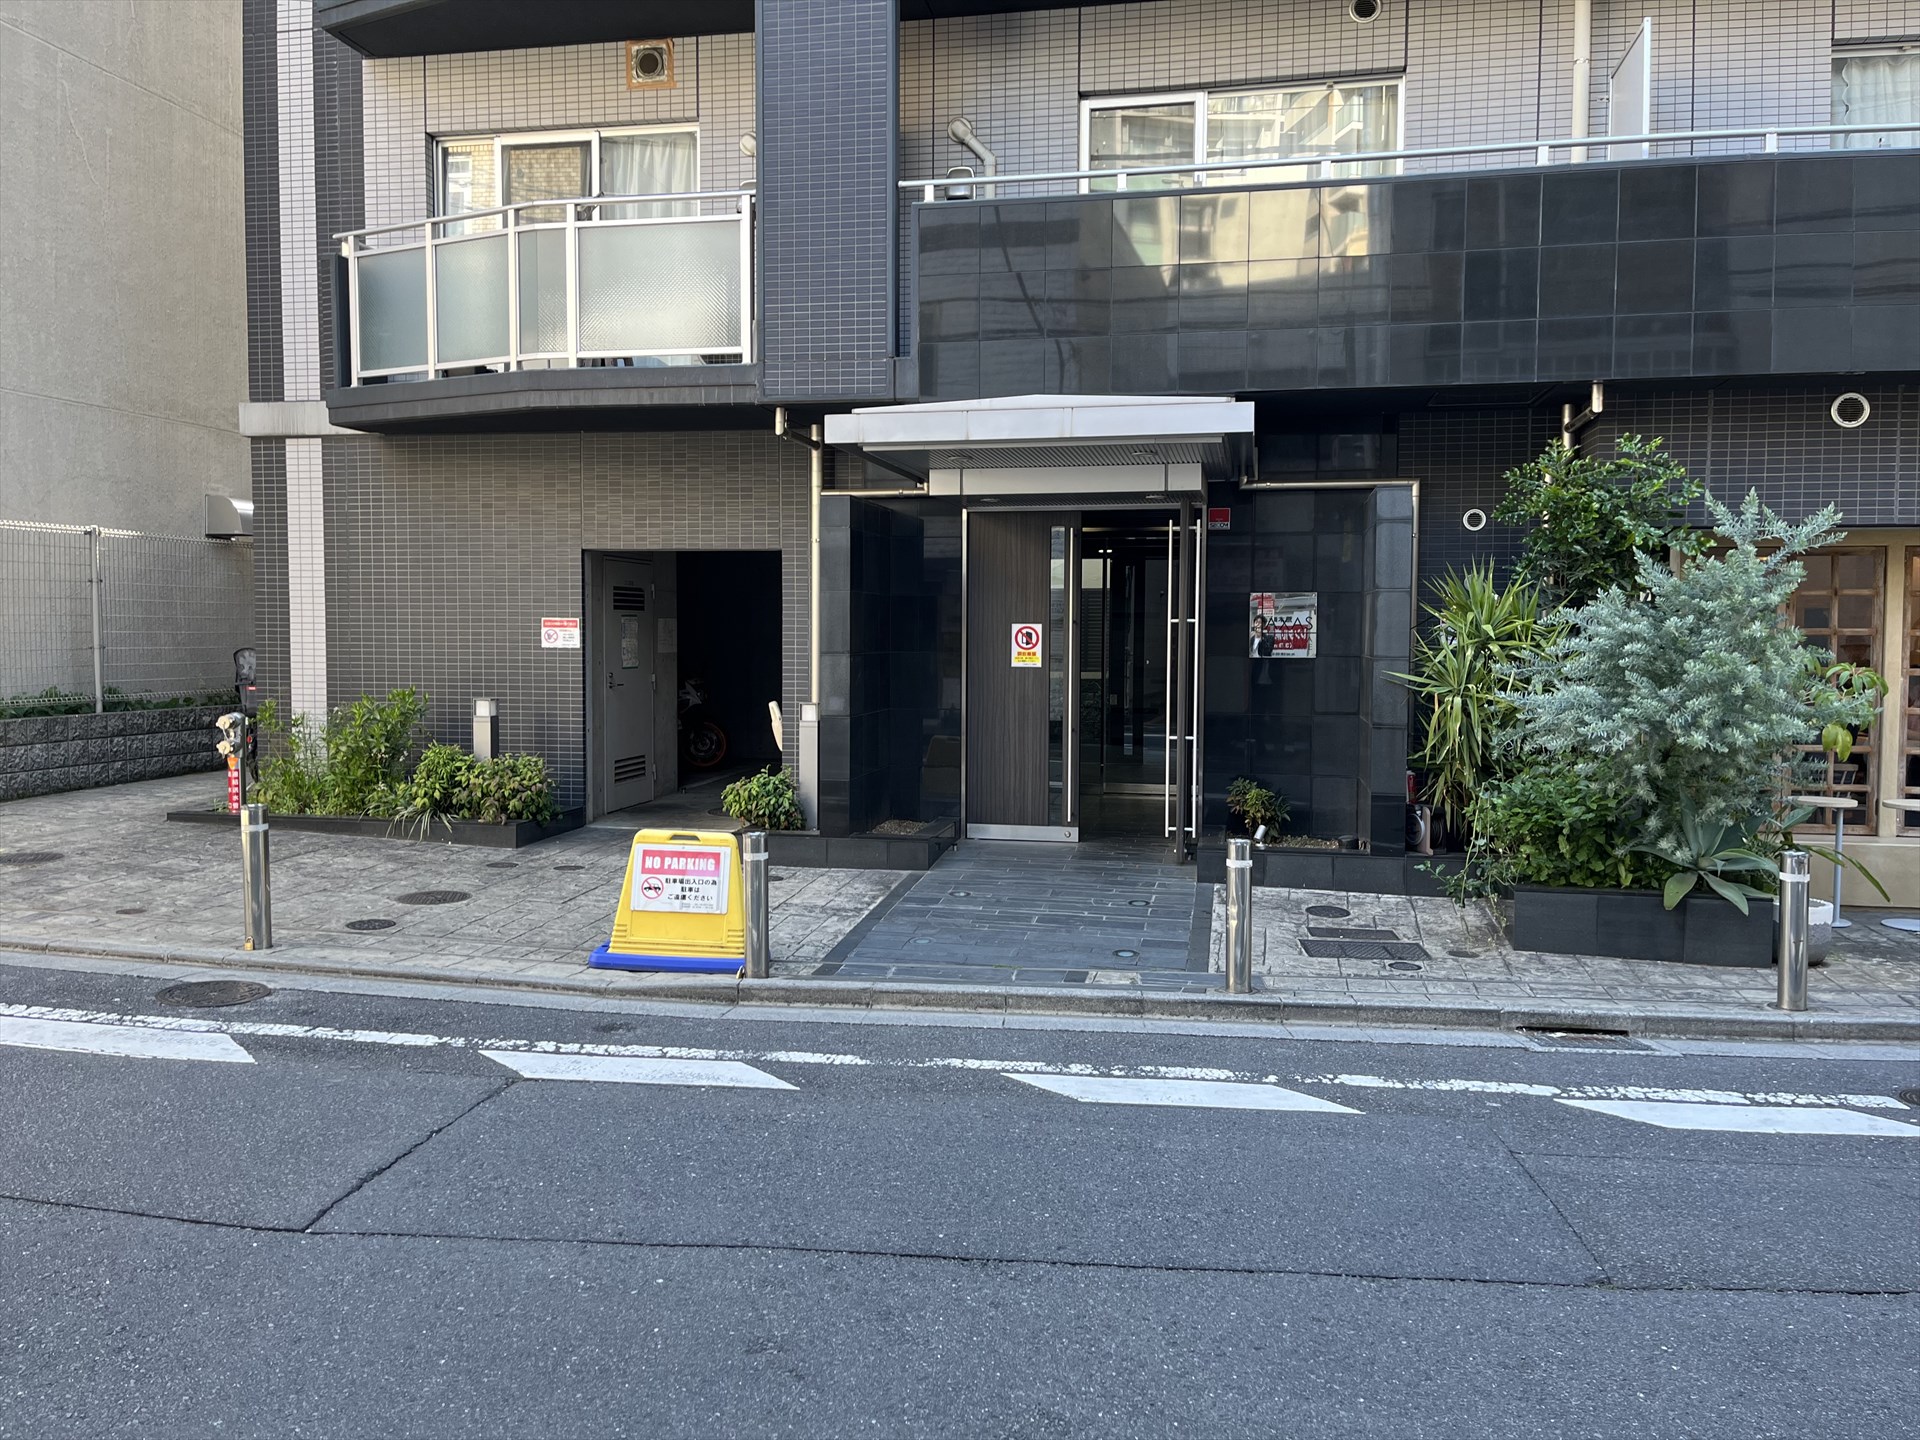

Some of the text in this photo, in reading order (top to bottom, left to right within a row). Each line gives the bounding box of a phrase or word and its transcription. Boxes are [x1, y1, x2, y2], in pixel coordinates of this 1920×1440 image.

[645, 856, 715, 871] NO PARKING
[665, 878, 717, 886] 駐車場出入口の為
[667, 893, 713, 901] ご遠慮ください
